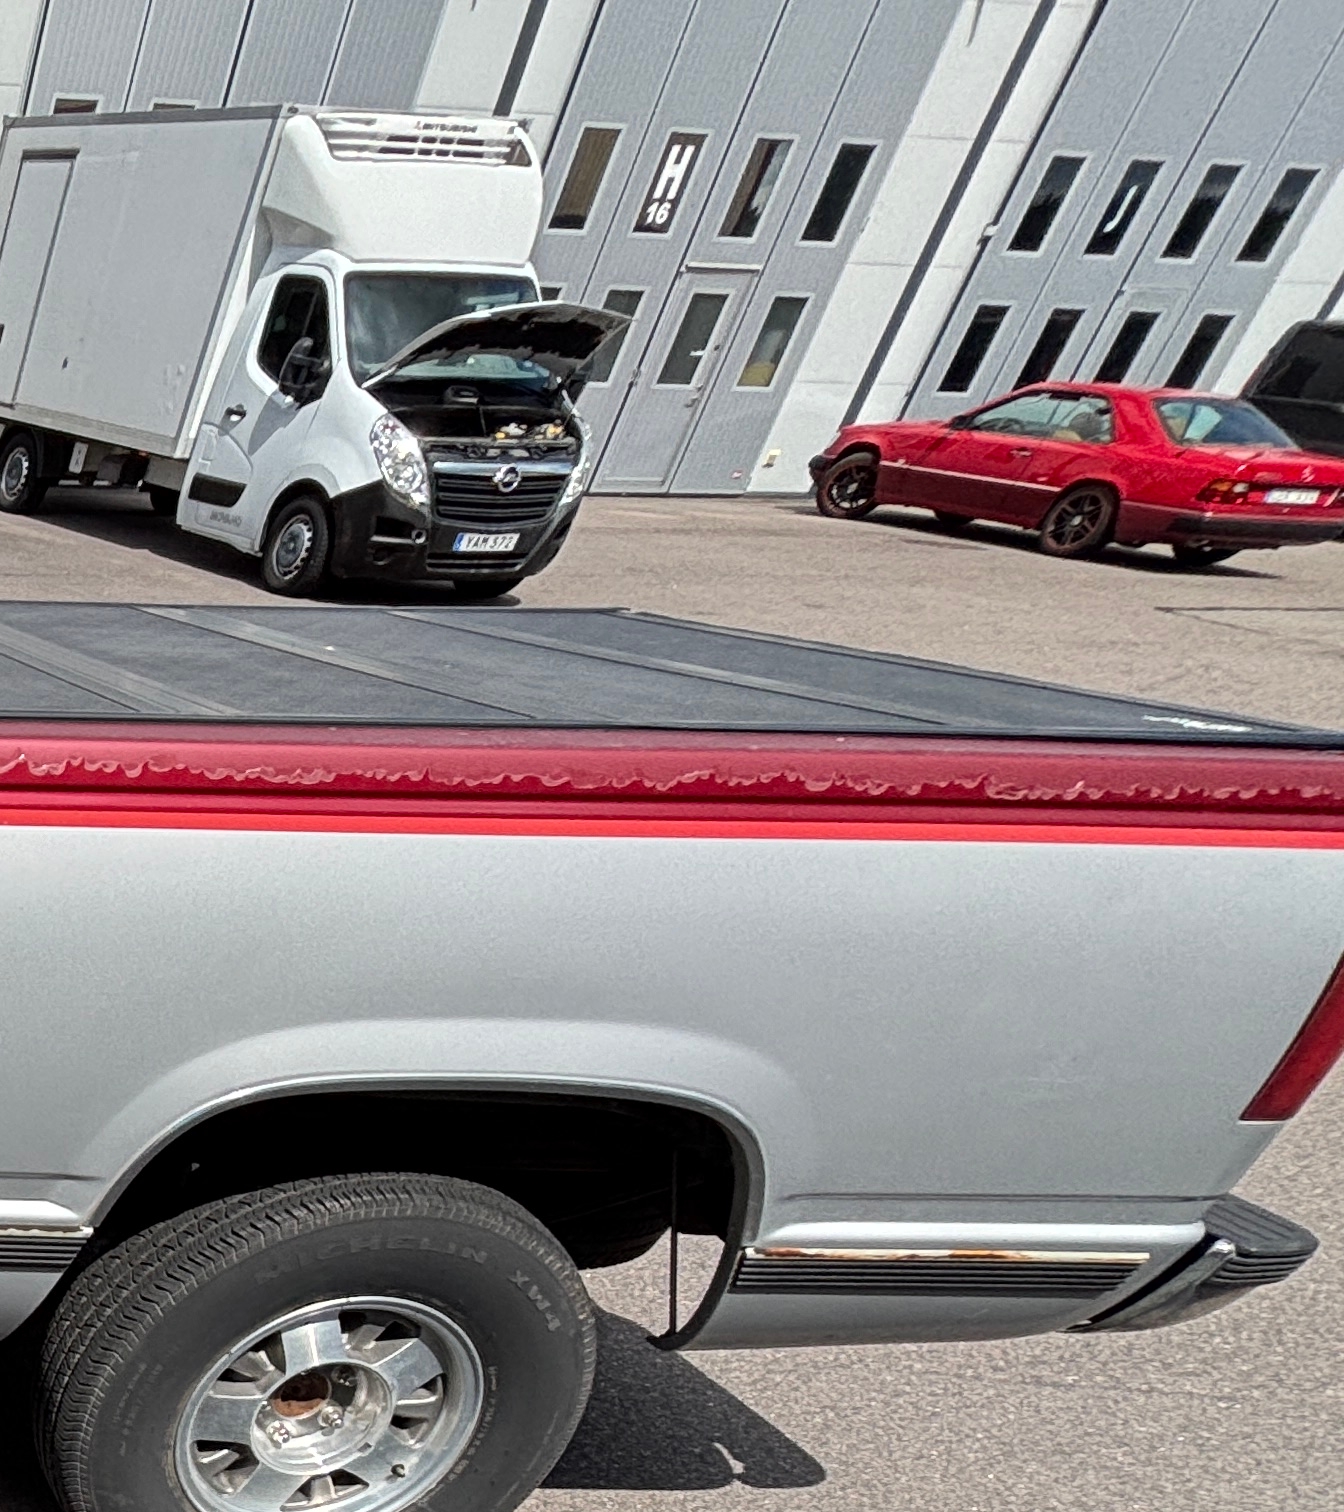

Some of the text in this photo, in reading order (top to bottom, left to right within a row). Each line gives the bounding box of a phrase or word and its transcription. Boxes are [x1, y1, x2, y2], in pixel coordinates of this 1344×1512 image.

[652, 144, 696, 200] H
[645, 201, 672, 225] 16
[1103, 184, 1139, 233] J
